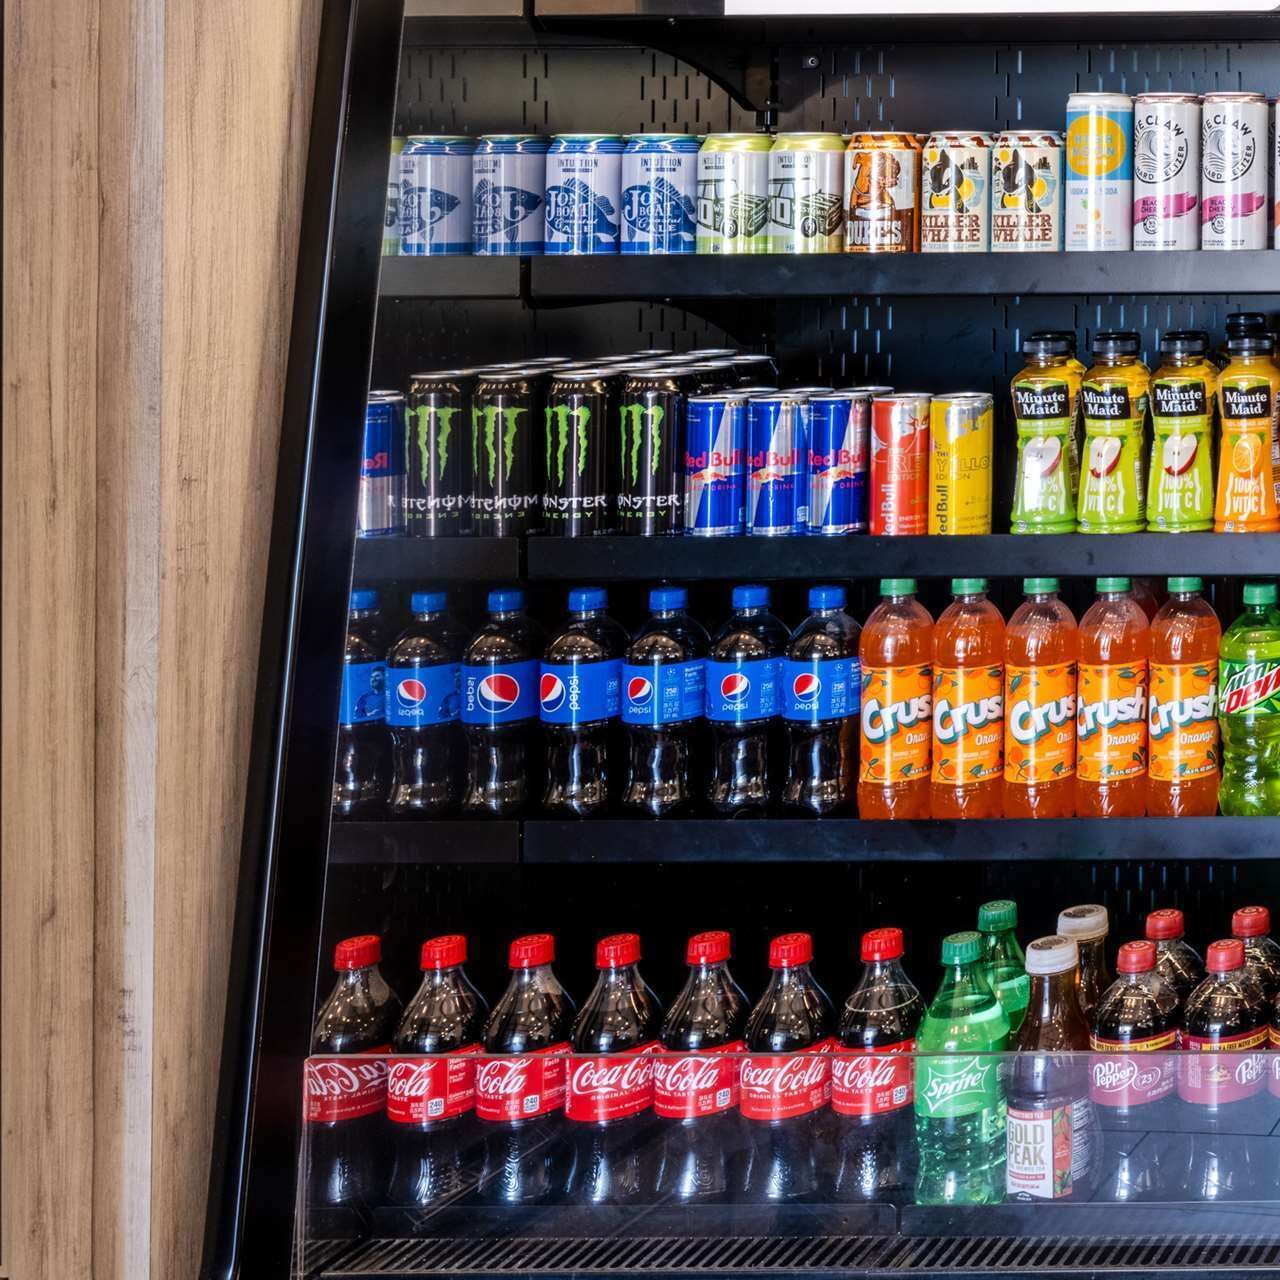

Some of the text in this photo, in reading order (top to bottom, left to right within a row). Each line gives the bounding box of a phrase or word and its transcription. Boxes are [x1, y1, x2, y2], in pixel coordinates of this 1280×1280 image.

[1145, 114, 1185, 137] CLAW
[1213, 114, 1253, 137] CLAW
[921, 214, 981, 228] KILLER
[992, 214, 1053, 228] KILLER
[921, 228, 981, 242] WHALE
[992, 228, 1053, 242] WHALE
[1017, 391, 1065, 404] Minute
[1083, 391, 1125, 404] Minute
[1156, 387, 1203, 401] Minute
[1225, 391, 1268, 403] Minute
[1022, 402, 1062, 416] Maid
[1088, 403, 1121, 416] Maid
[1161, 399, 1198, 413] Maid
[1231, 402, 1264, 416] Maid
[710, 451, 743, 467] Bull
[766, 451, 799, 467] Bull
[627, 704, 652, 715] pepsi
[721, 701, 749, 712] pepsi
[793, 700, 819, 712] pepsi
[863, 694, 932, 741] Crus
[934, 694, 1003, 740] Crus
[1010, 693, 1076, 741] Crus
[1179, 730, 1214, 746] Orange
[740, 1054, 827, 1094] Coca-Cola
[1094, 1064, 1135, 1089] Pepper
[1141, 1074, 1153, 1085] 23
[930, 1069, 984, 1097] Sprite
[525, 1096, 538, 1105] 240
[717, 1089, 730, 1099] 240
[749, 1091, 783, 1100] ORIGINAL
[1008, 1120, 1045, 1145] GOLD
[1008, 1142, 1046, 1167] PEAK
